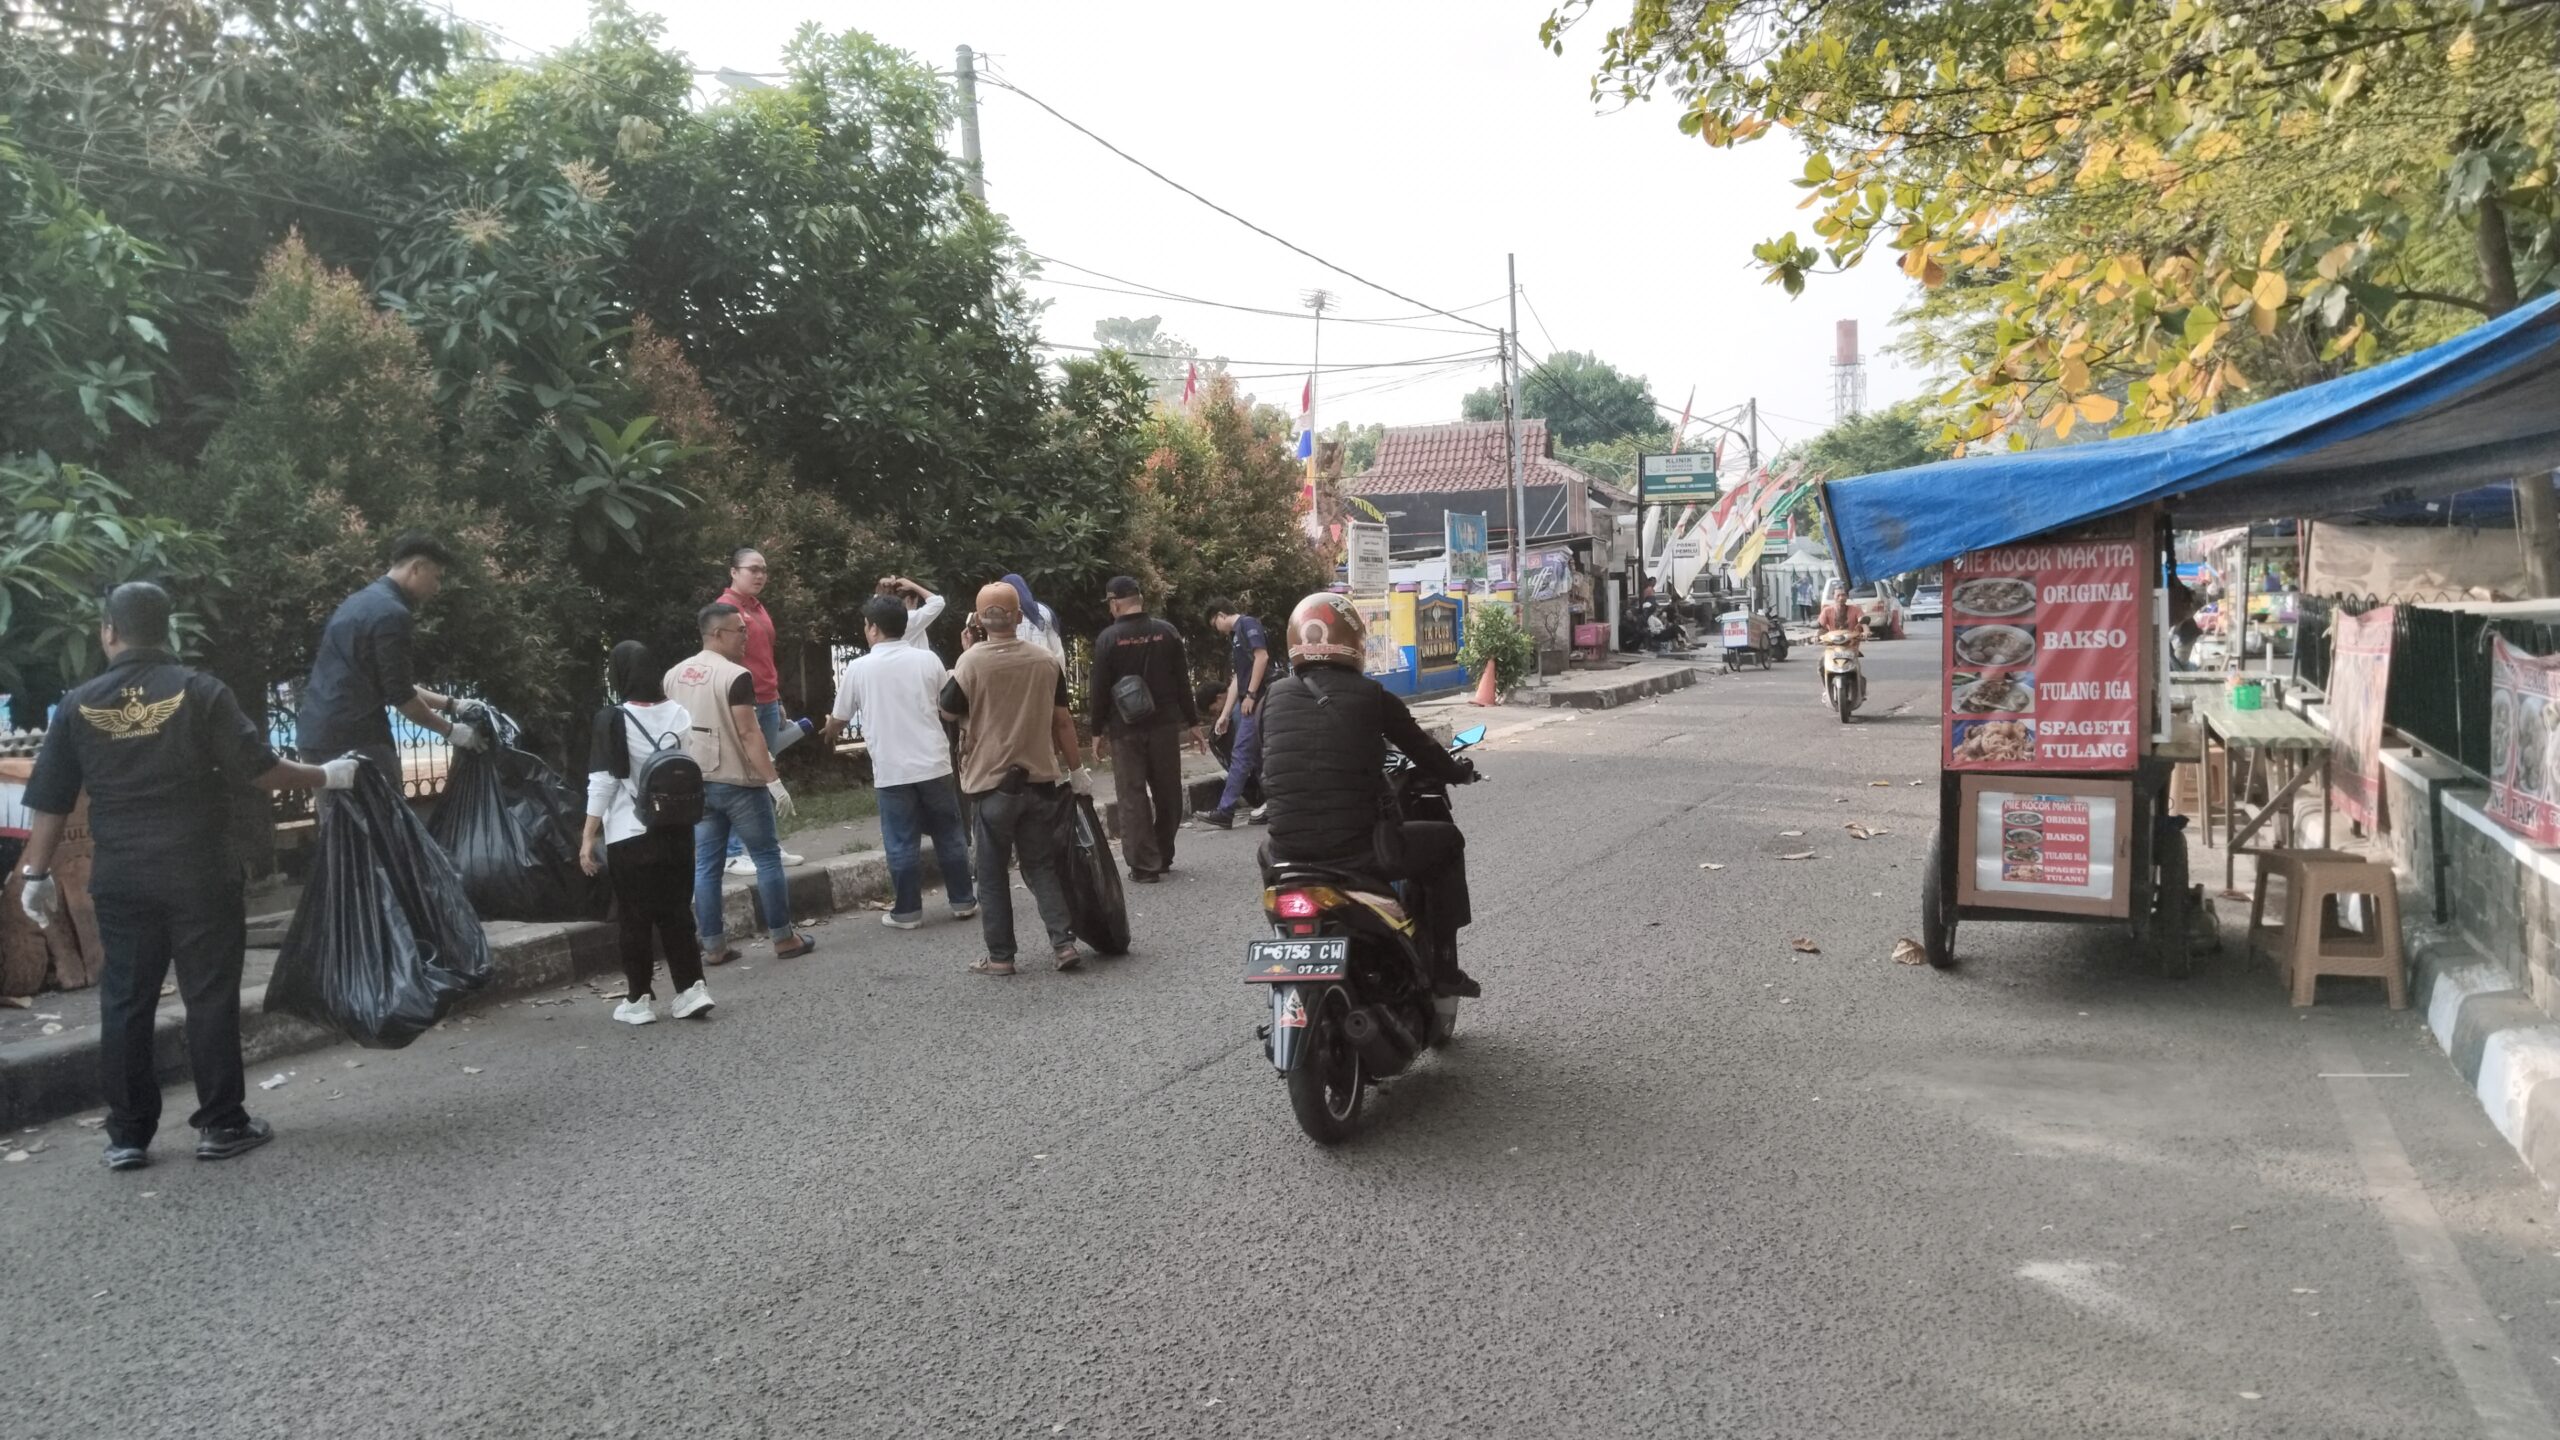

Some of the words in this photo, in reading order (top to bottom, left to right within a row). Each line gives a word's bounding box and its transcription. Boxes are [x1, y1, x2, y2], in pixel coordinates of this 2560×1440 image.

[1990, 547, 2052, 572] KOCOK
[2056, 544, 2135, 571] MAK'ITA
[2043, 582, 2133, 604] ORIGINAL
[2042, 629, 2128, 650] BAKSO
[120, 686, 144, 697] 354
[2039, 682, 2101, 701] TULANG
[2104, 681, 2133, 700] IGA
[111, 727, 160, 740] INDONESIA
[2039, 720, 2131, 736] SPAGETI
[2041, 743, 2128, 758] TULANG
[2004, 800, 2020, 809] MIE
[2021, 801, 2050, 810] KOCOK
[2045, 816, 2088, 825] ORIGINAL
[2045, 833, 2085, 842] BAKSO
[2044, 852, 2072, 860] TULANG
[2074, 852, 2087, 861] IGA
[2044, 867, 2087, 875] SPAGETI
[2046, 874, 2085, 882] TULANG
[1253, 945, 1263, 961] T
[1272, 944, 1311, 959] 6756
[1319, 943, 1343, 959] CW
